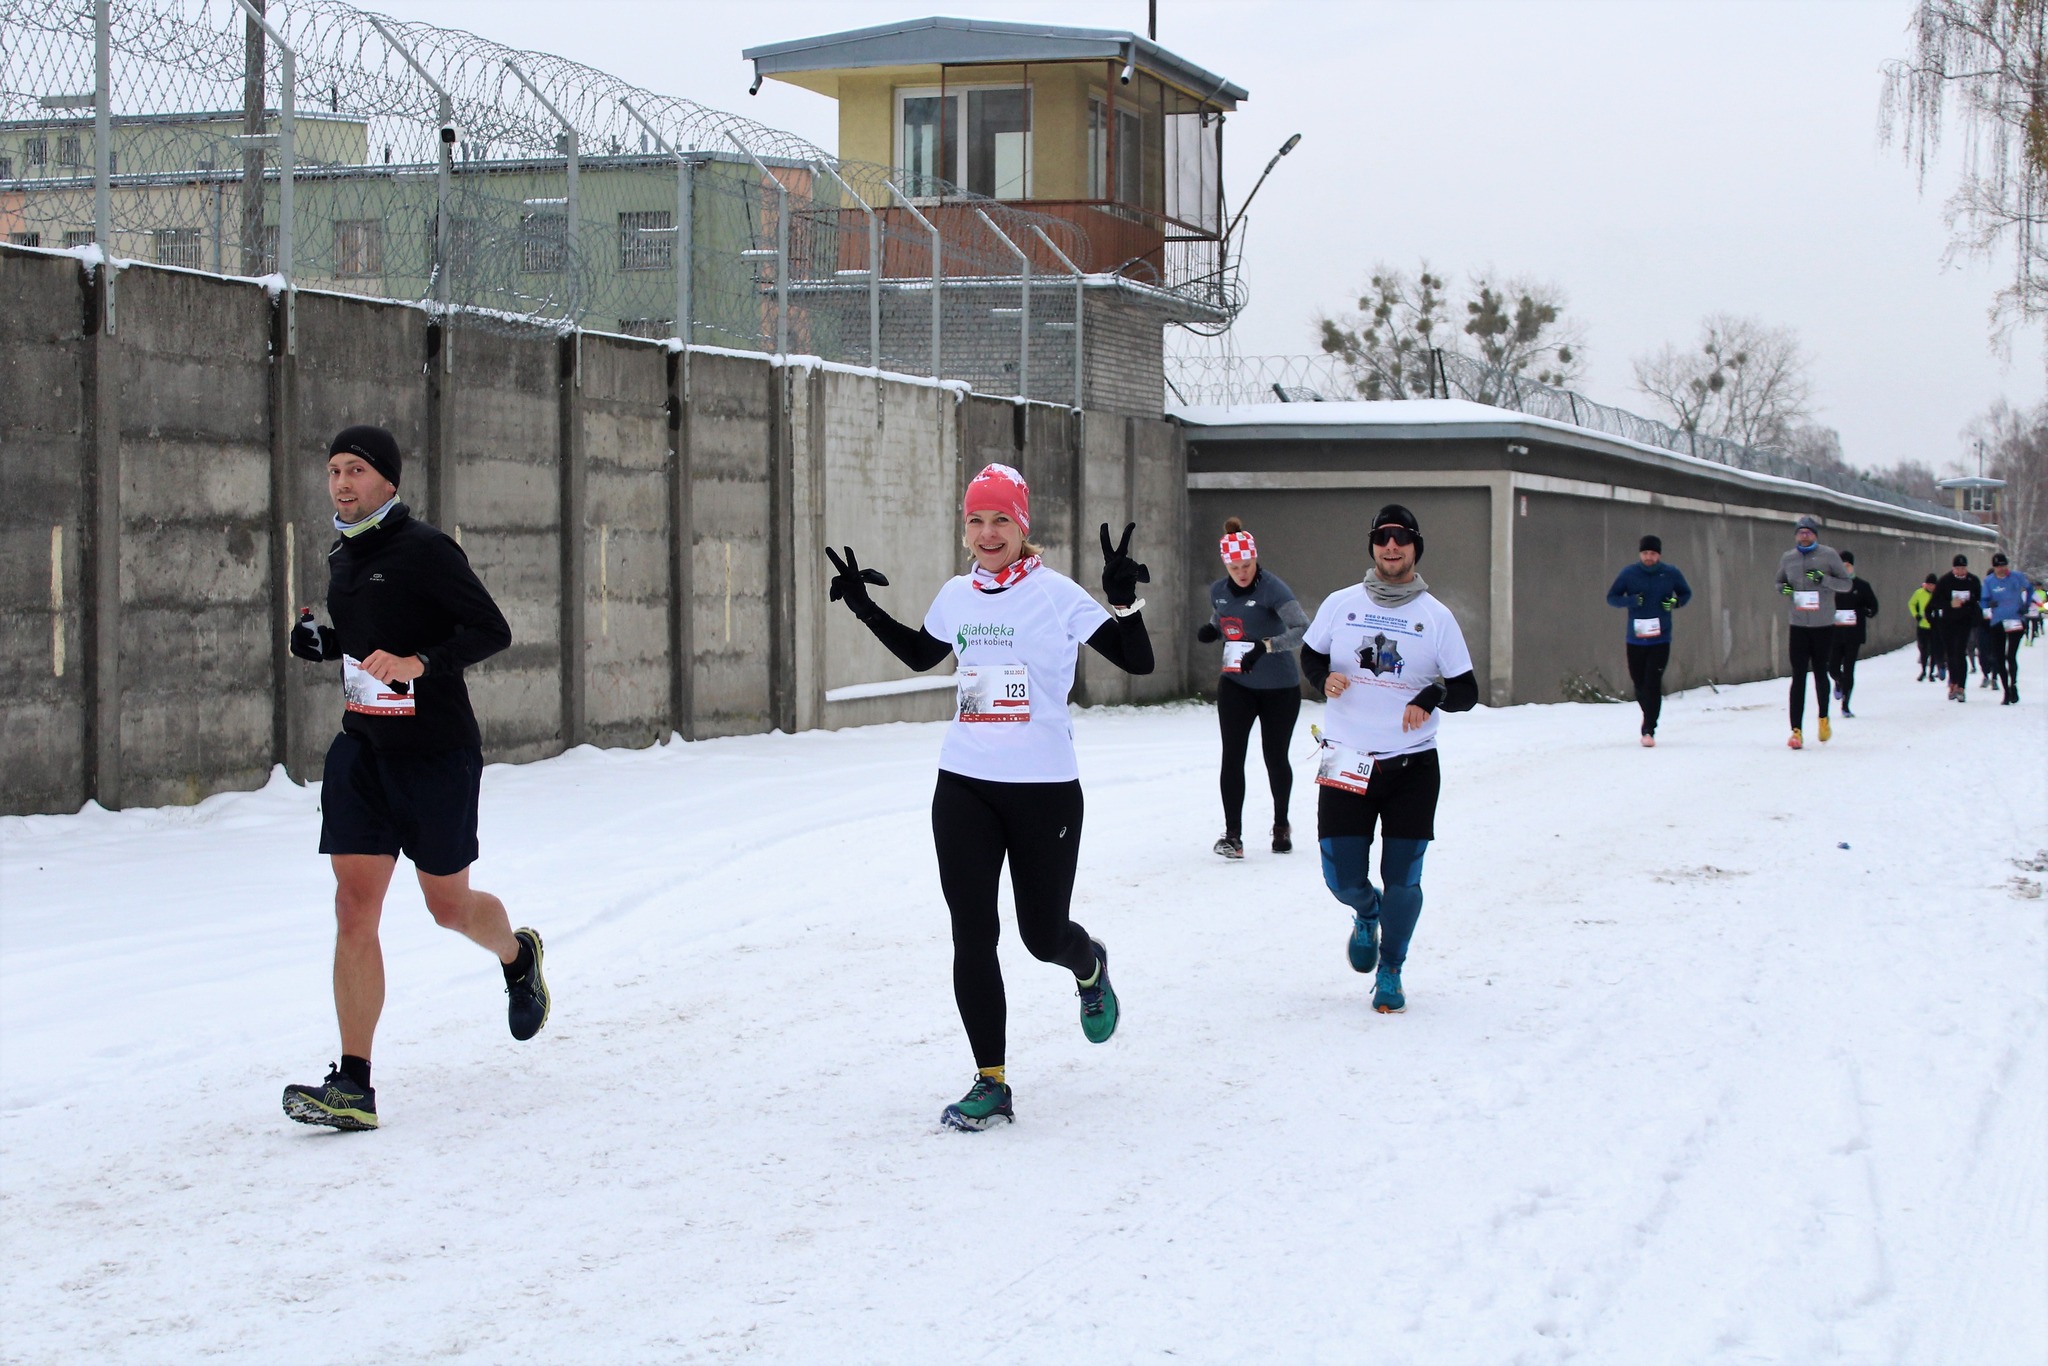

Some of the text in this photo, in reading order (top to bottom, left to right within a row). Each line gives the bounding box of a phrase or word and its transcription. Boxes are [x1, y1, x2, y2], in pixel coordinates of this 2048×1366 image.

[962, 623, 1014, 639] Białołęka
[968, 638, 1013, 648] jest kobietą
[1005, 683, 1026, 698] 123
[1357, 762, 1370, 775] 50
